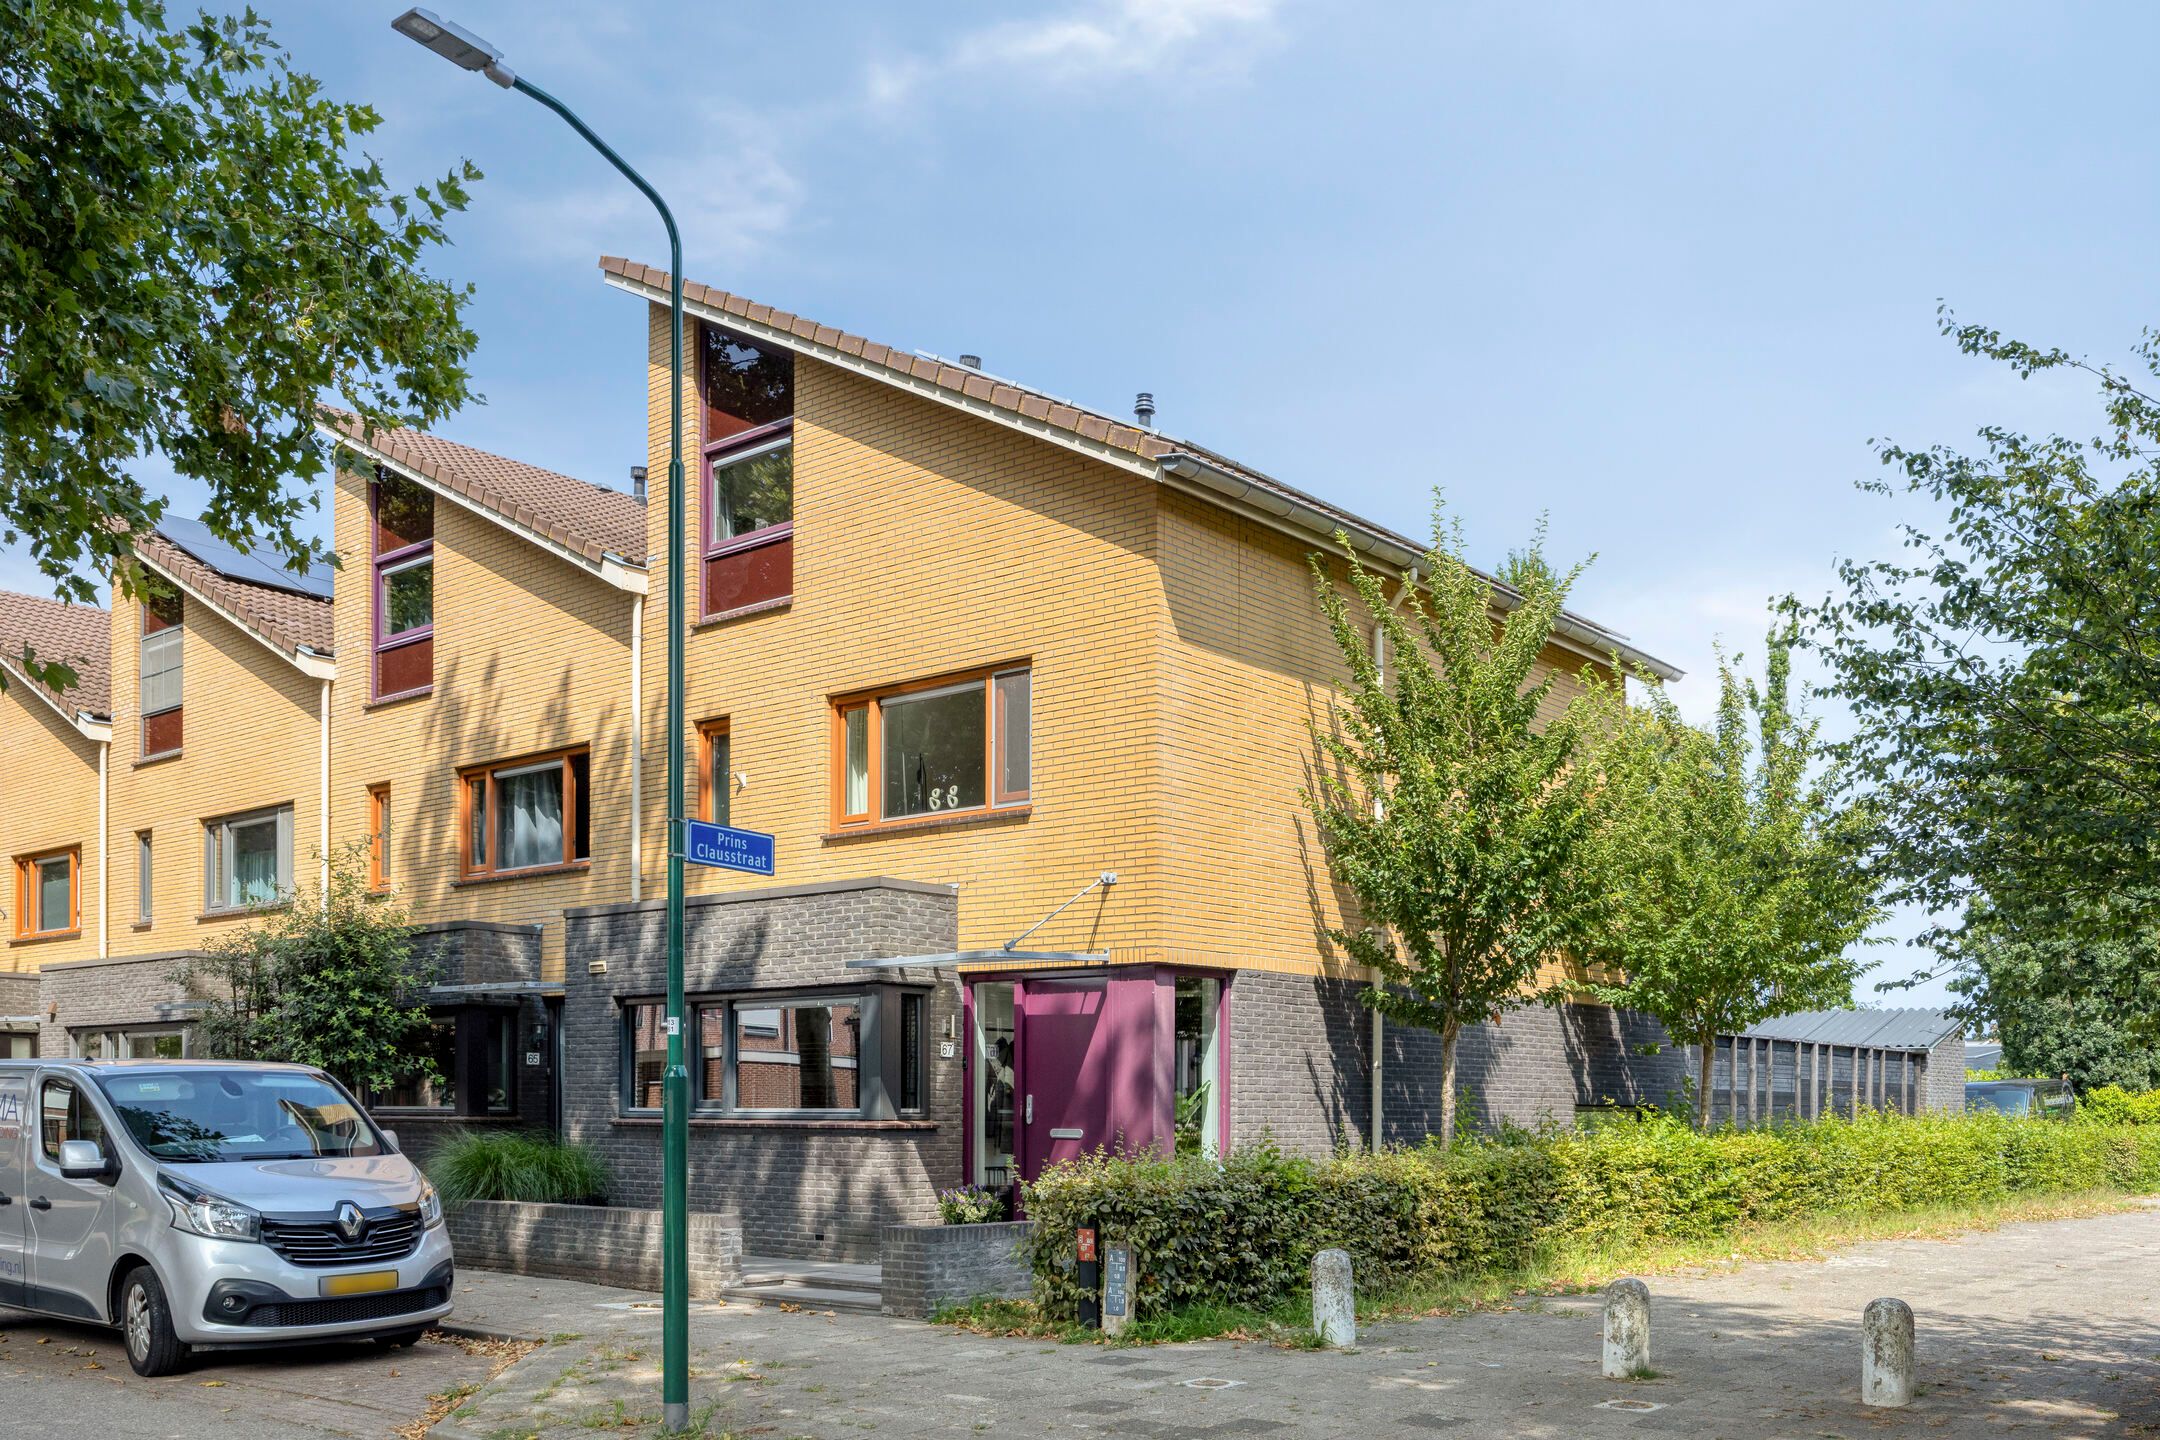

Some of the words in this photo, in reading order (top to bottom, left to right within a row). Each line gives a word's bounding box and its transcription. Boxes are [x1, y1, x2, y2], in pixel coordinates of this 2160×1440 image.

[718, 832, 747, 849] Prins
[696, 843, 767, 868] Clausstraat
[942, 1044, 953, 1056] 67
[528, 1054, 539, 1064] 65
